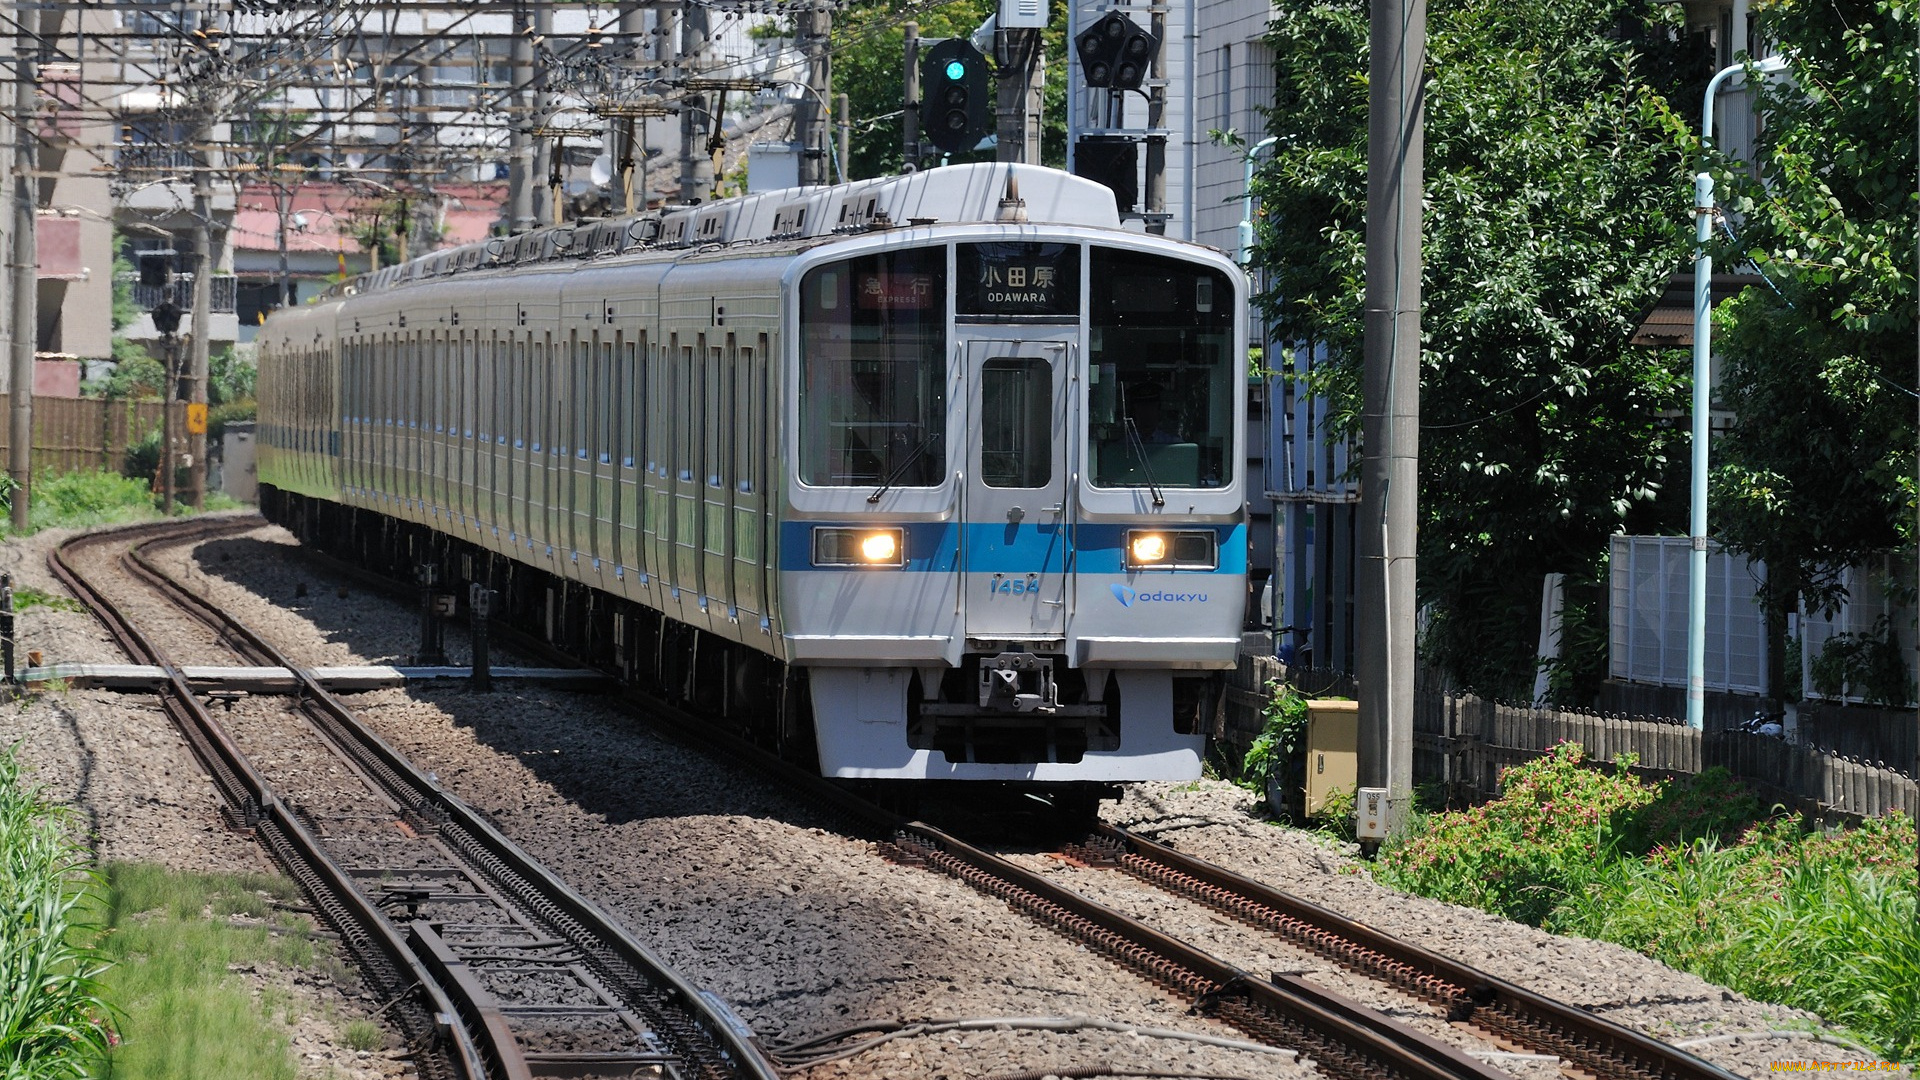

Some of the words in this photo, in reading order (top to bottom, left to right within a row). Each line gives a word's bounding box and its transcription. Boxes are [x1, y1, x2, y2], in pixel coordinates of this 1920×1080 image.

[980, 266, 1055, 288] 小田原
[987, 292, 1047, 303] ODAWARA
[991, 579, 1039, 595] 1454
